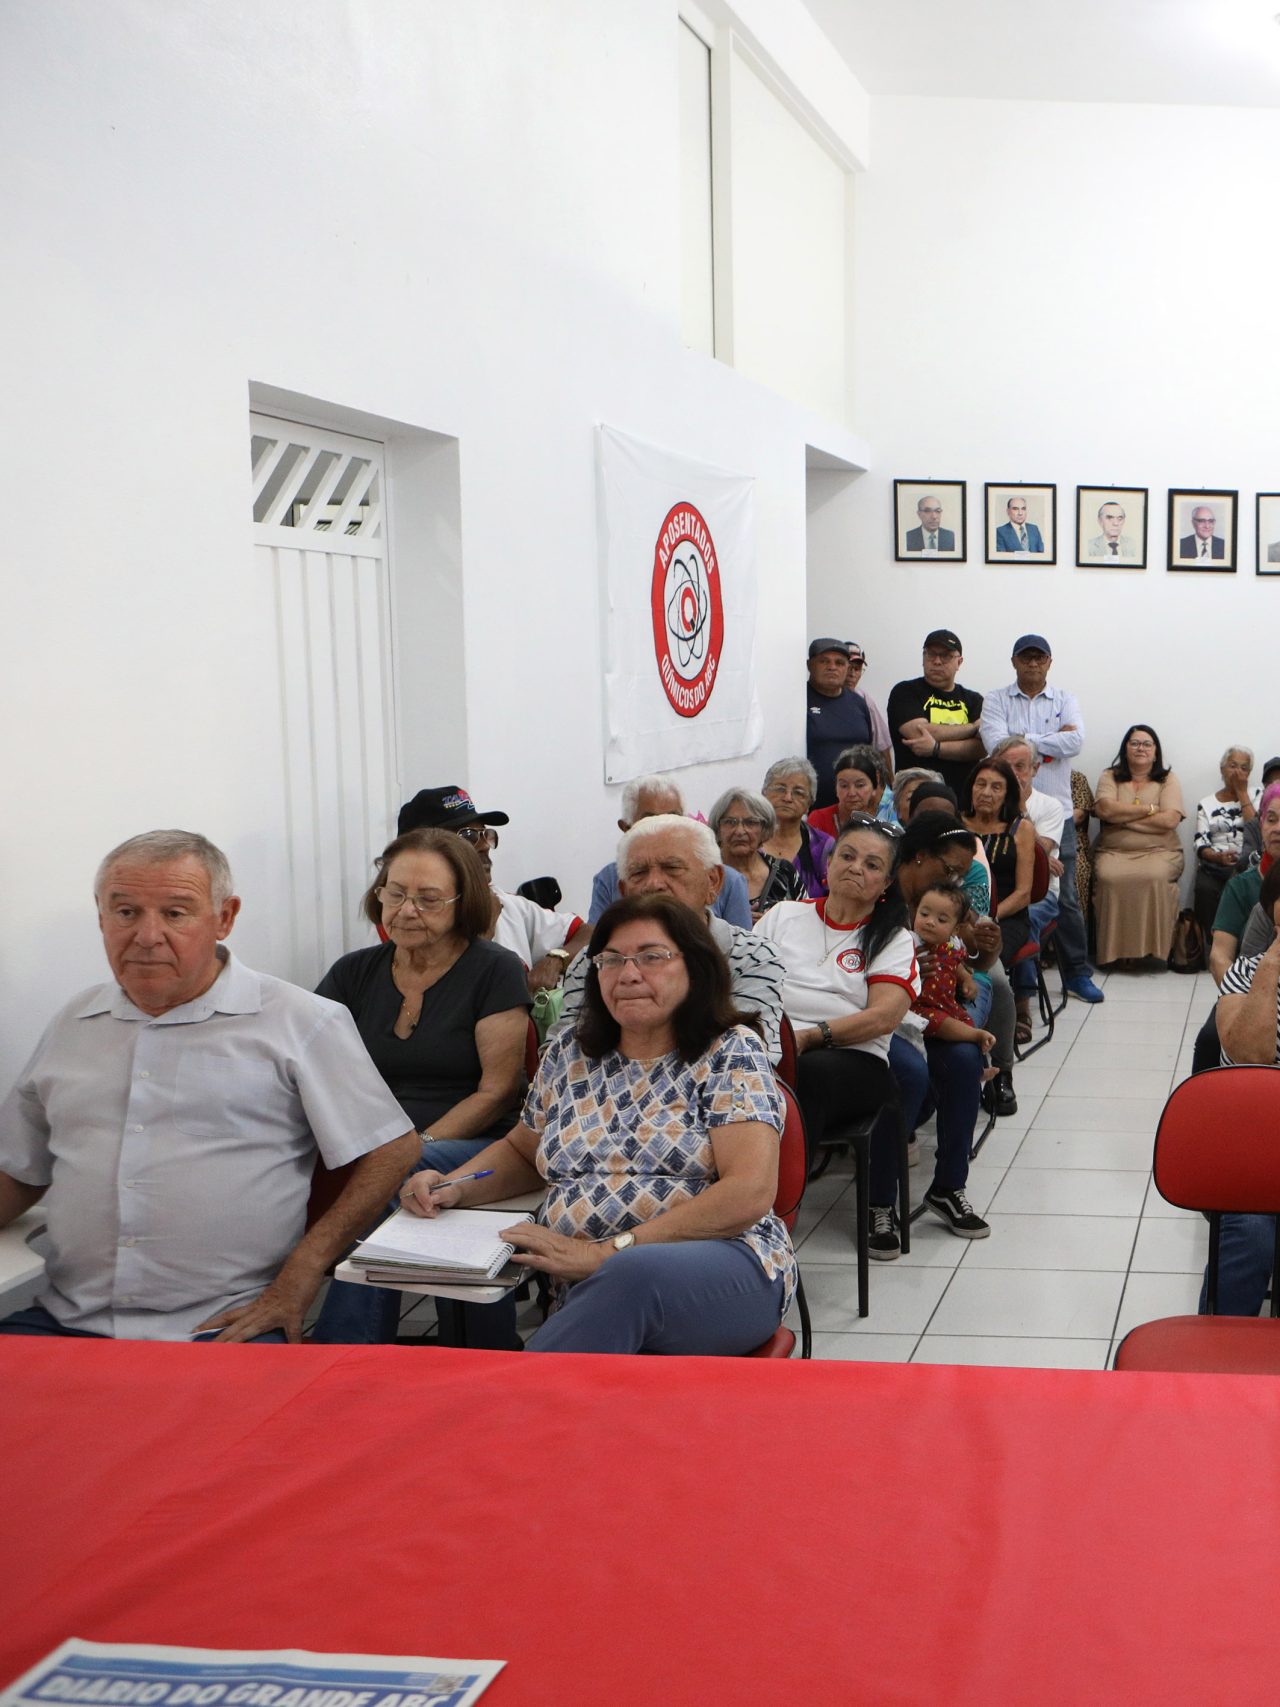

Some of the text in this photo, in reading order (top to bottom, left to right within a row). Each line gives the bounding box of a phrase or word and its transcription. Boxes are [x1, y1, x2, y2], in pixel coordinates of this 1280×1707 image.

[658, 511, 715, 574] APOSENTADOS
[694, 681, 705, 706] DO
[705, 653, 716, 691] ABC
[36, 1675, 172, 1704] DIÁRIO
[163, 1682, 229, 1705] DO
[223, 1682, 371, 1707] GRANDE
